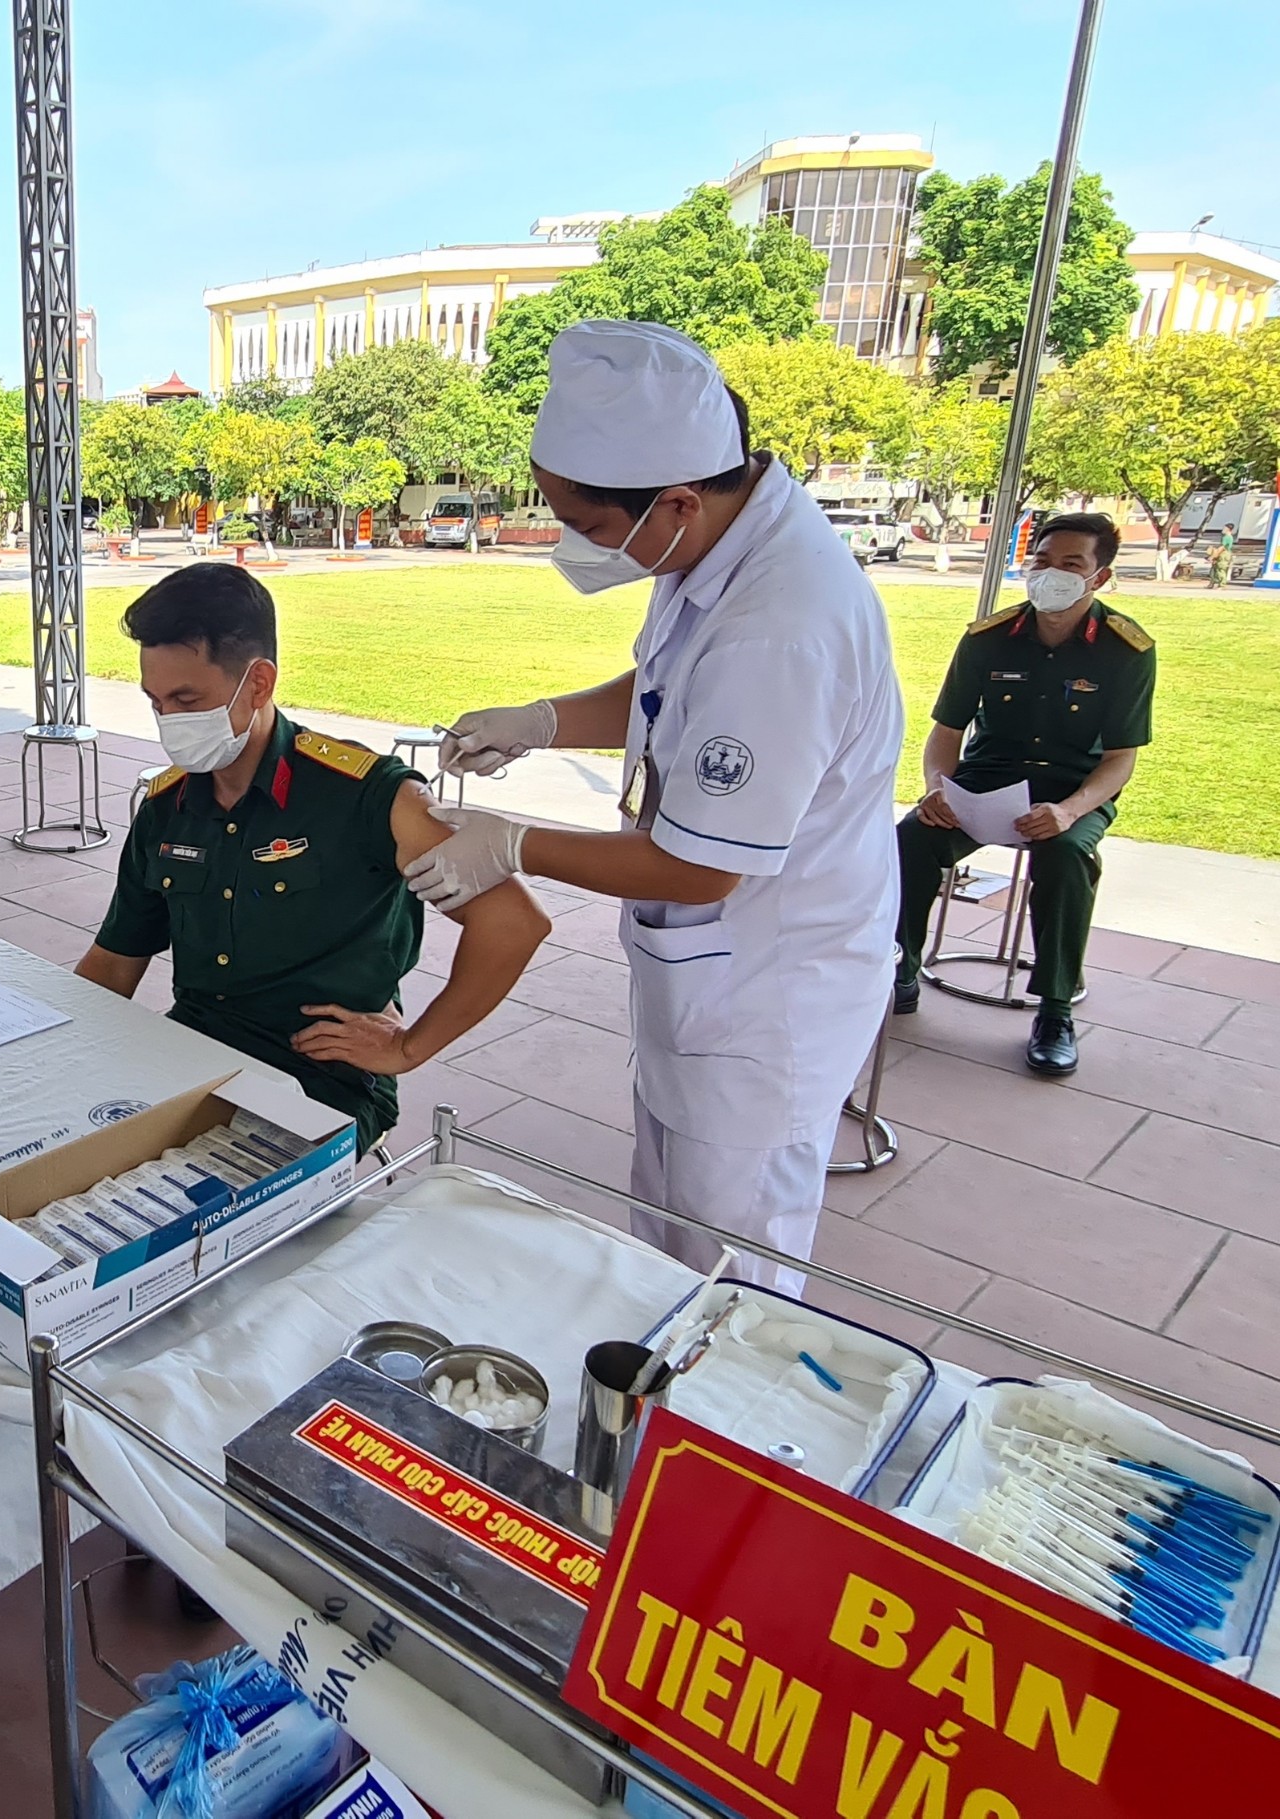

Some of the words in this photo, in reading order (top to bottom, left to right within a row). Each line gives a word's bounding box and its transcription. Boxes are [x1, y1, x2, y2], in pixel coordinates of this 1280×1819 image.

[261, 1168, 304, 1197] SYRINGES
[50, 1310, 91, 1334] UTO-DISABLE
[318, 1414, 347, 1437] VỆ
[441, 1489, 489, 1522] CẤP
[485, 1511, 560, 1564] THUỐC
[312, 1667, 357, 1723] VIỆ
[625, 1590, 822, 1786] TIÊM
[829, 1572, 1120, 1785] BÀN
[337, 1788, 383, 1819] VINA
